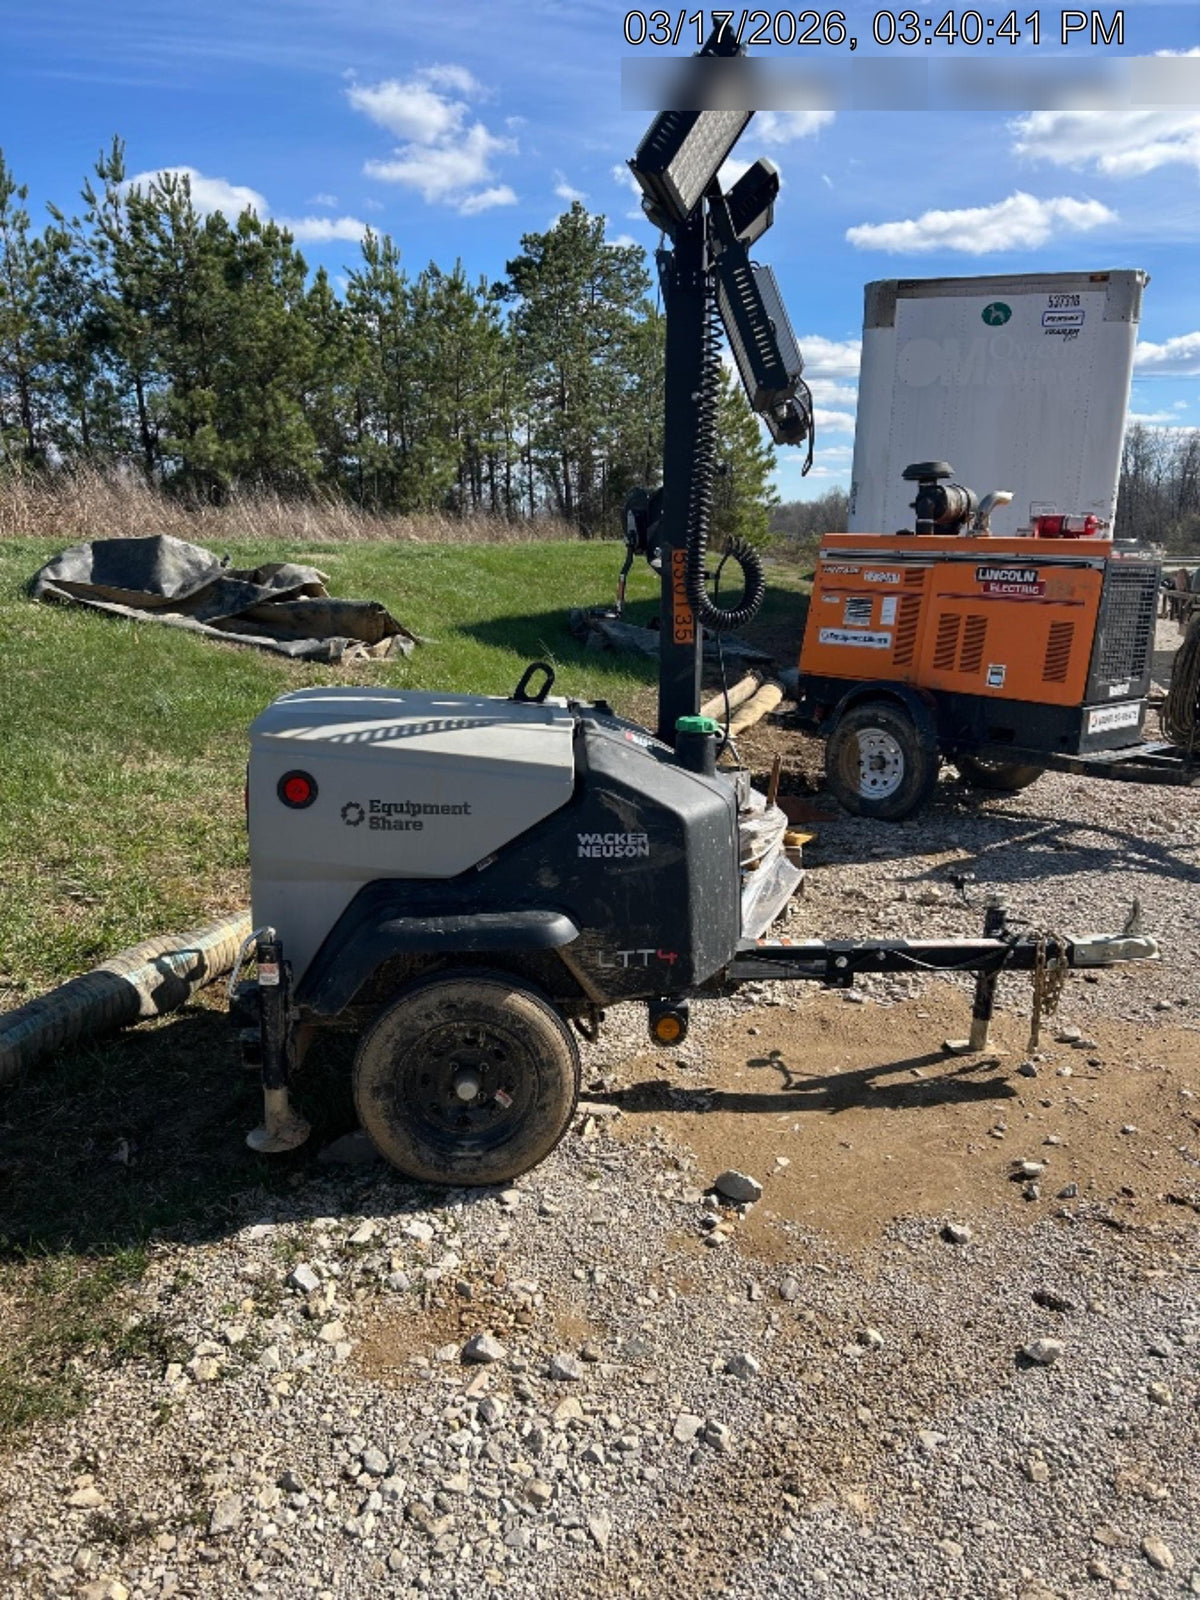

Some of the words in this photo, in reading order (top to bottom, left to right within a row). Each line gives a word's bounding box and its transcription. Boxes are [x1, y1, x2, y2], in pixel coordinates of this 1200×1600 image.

[978, 568, 1036, 582] LINCOLN
[989, 582, 1040, 595] ELECTRIC
[368, 799, 472, 817] Equipment
[368, 816, 424, 831] Share
[577, 833, 649, 846] WACKER
[577, 845, 650, 858] NEUSON
